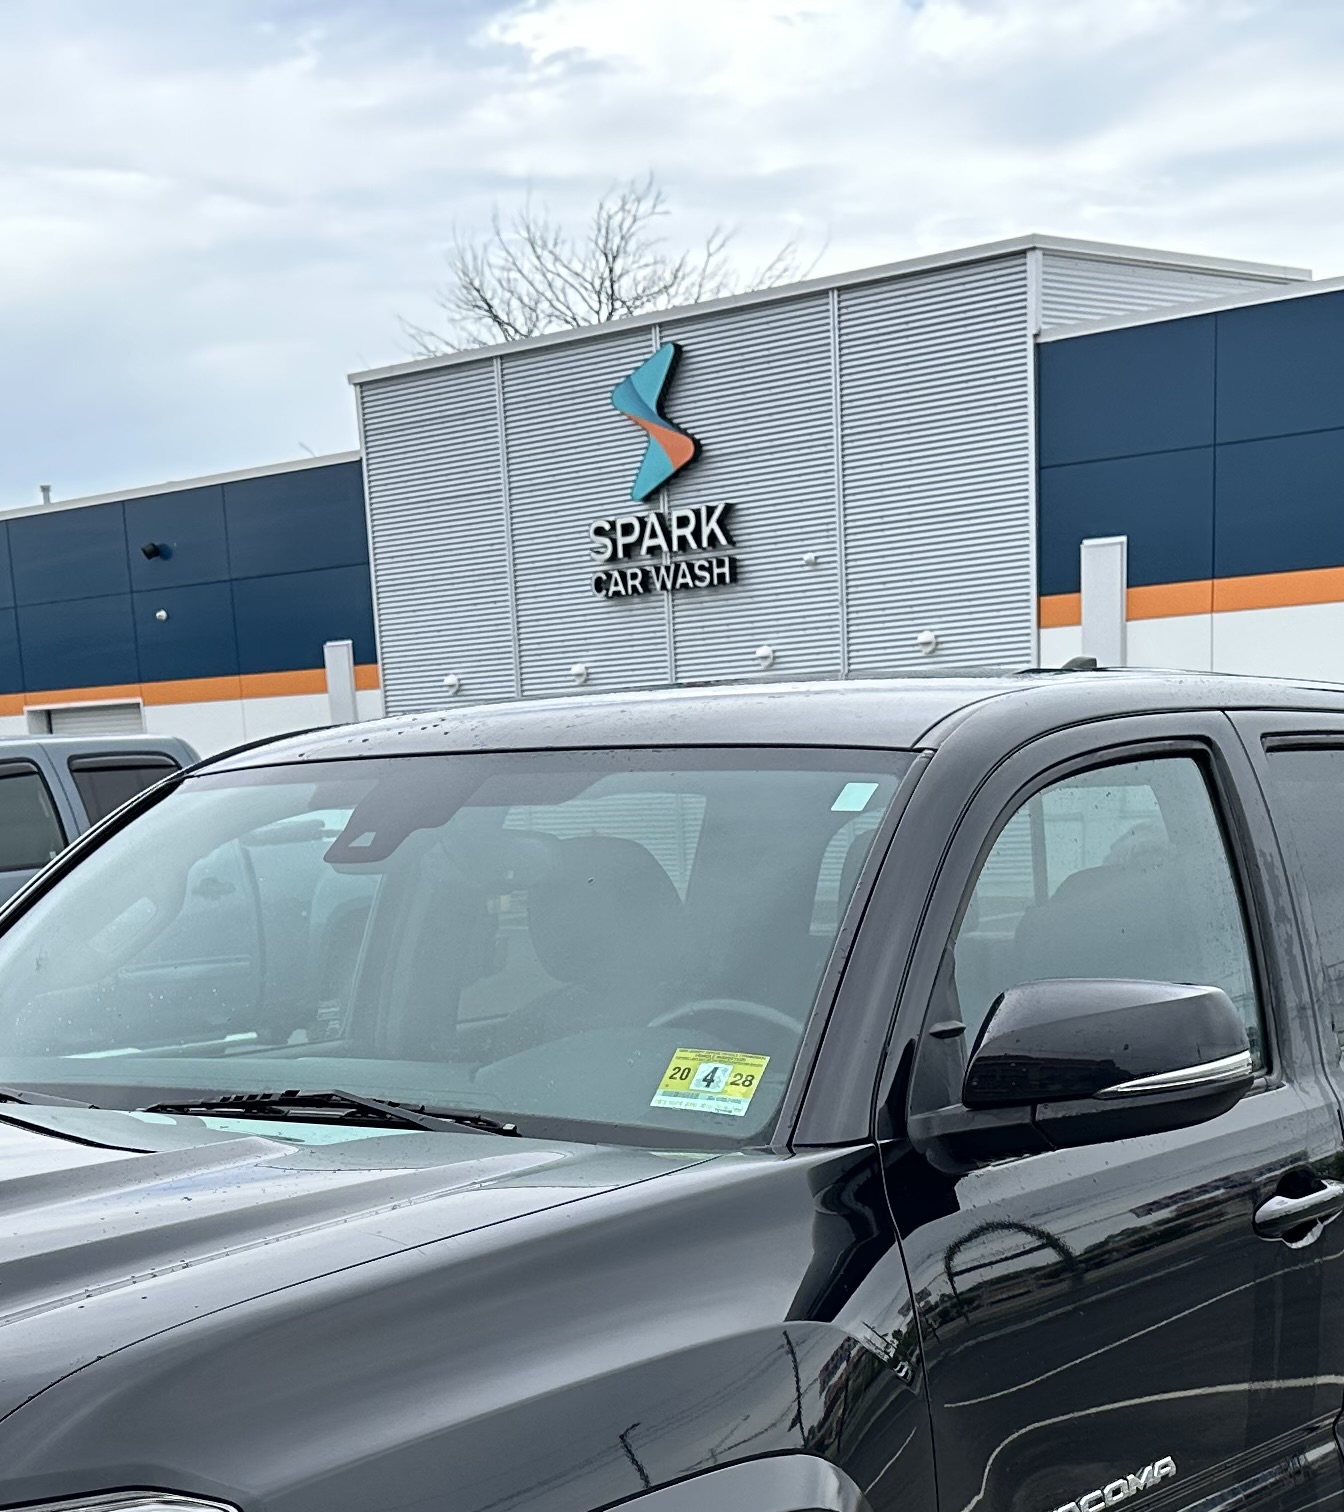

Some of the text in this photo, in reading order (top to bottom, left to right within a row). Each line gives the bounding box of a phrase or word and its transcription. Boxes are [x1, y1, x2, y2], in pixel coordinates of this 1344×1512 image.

[589, 502, 729, 564] SPARK
[591, 556, 731, 599] CAR WASH
[668, 1066, 756, 1088] 20 4 28
